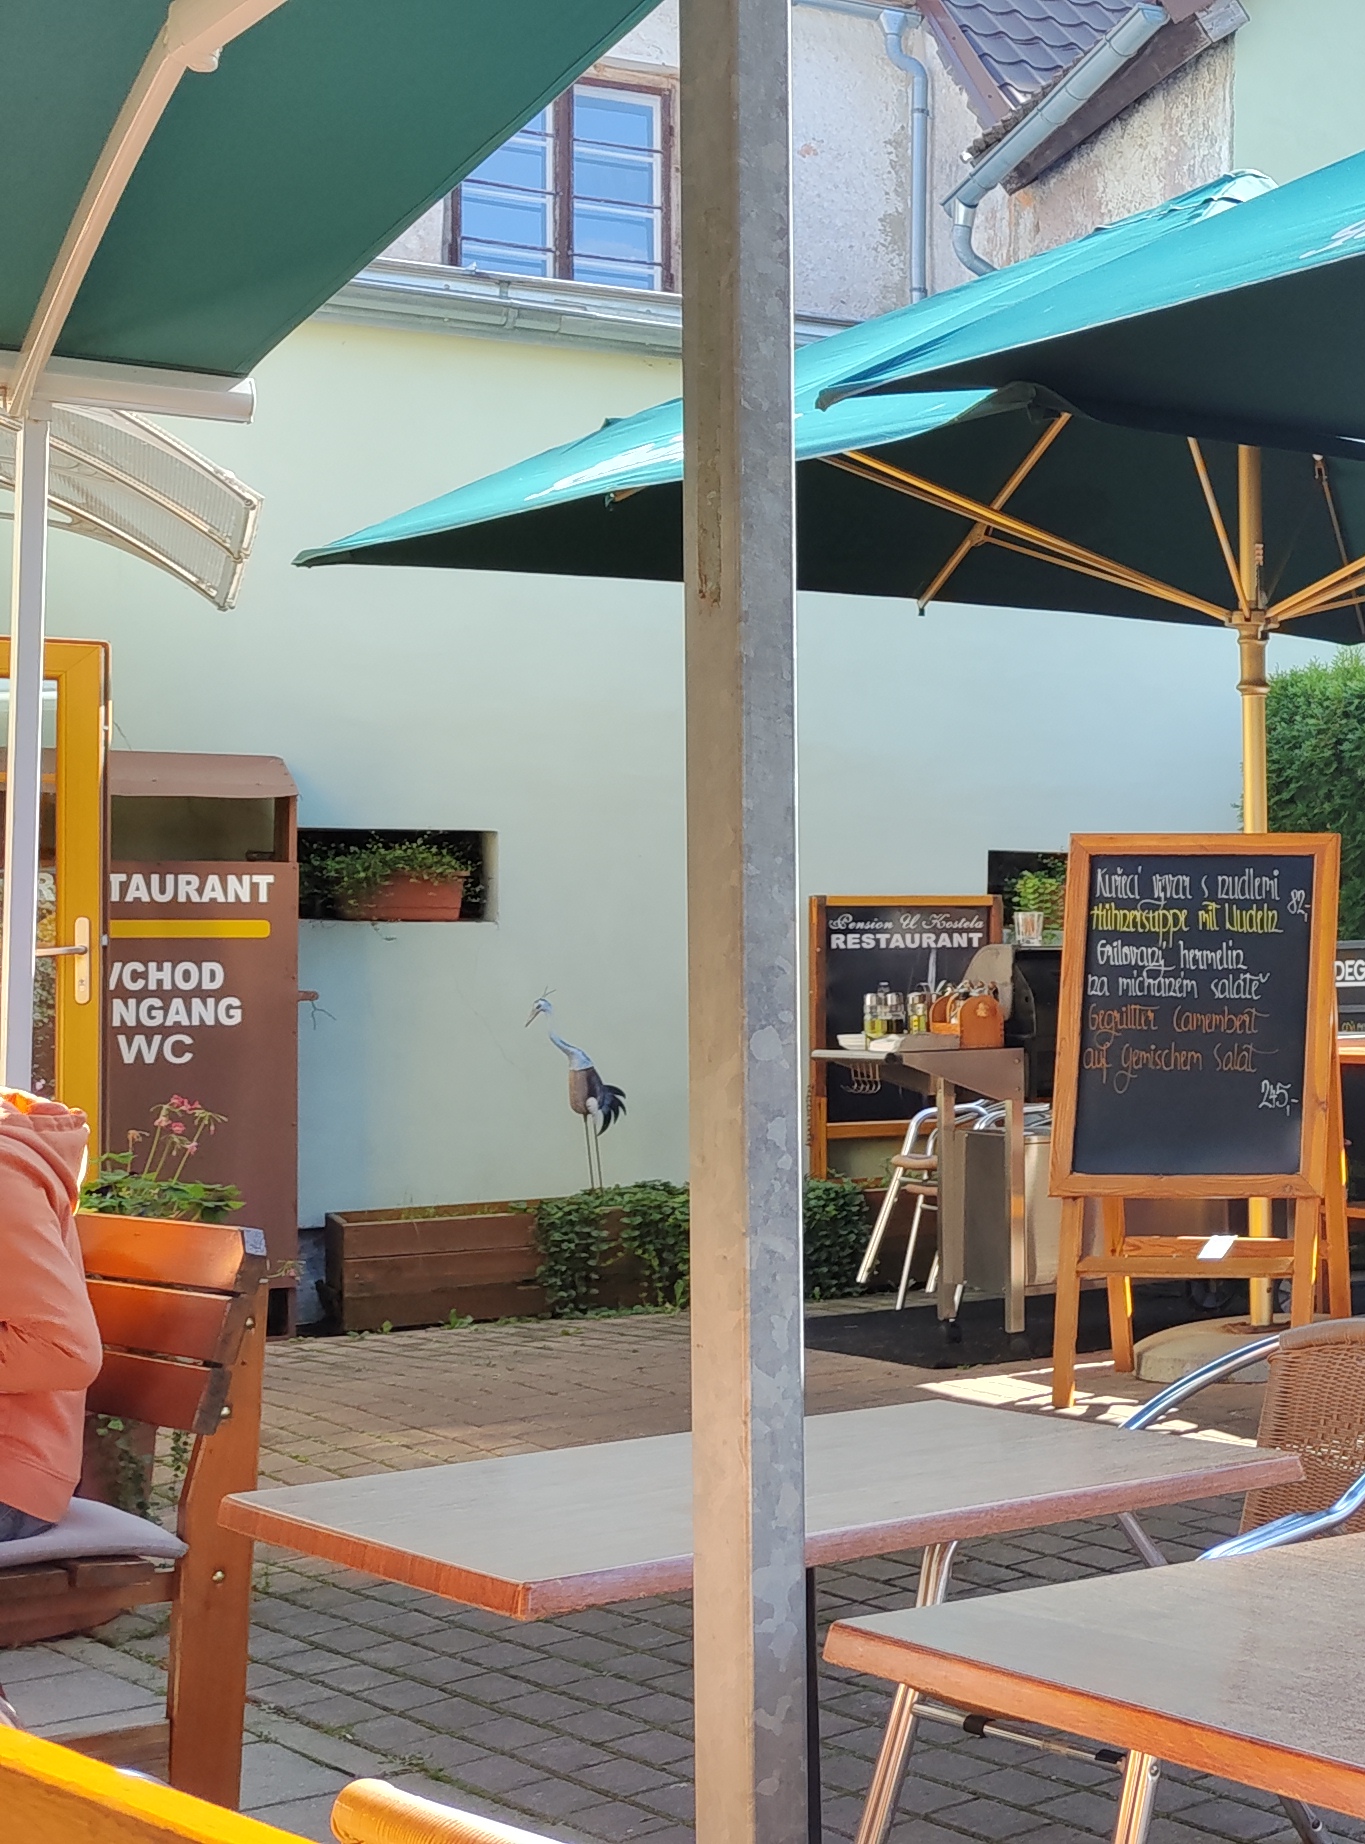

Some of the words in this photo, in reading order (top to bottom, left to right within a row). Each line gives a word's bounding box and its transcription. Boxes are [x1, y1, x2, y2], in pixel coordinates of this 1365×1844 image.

[1095, 866, 1142, 899] Kuřecí
[1201, 874, 1209, 899] s
[1218, 868, 1281, 900] nudlemi
[828, 913, 894, 930] Pension
[900, 913, 921, 930] U
[922, 913, 985, 930] Kostela
[1090, 902, 1190, 948] Hühnersuppe
[1198, 901, 1221, 931] mit
[1225, 902, 1284, 933] Nudeln
[830, 932, 984, 949] RESTAURANT
[1096, 940, 1176, 974] Grilovaný
[1088, 973, 1110, 996] na
[111, 997, 242, 1027] NGANG
[1173, 1005, 1270, 1034] Camembert
[117, 1034, 194, 1064] WC
[1082, 1041, 1112, 1084] auf
